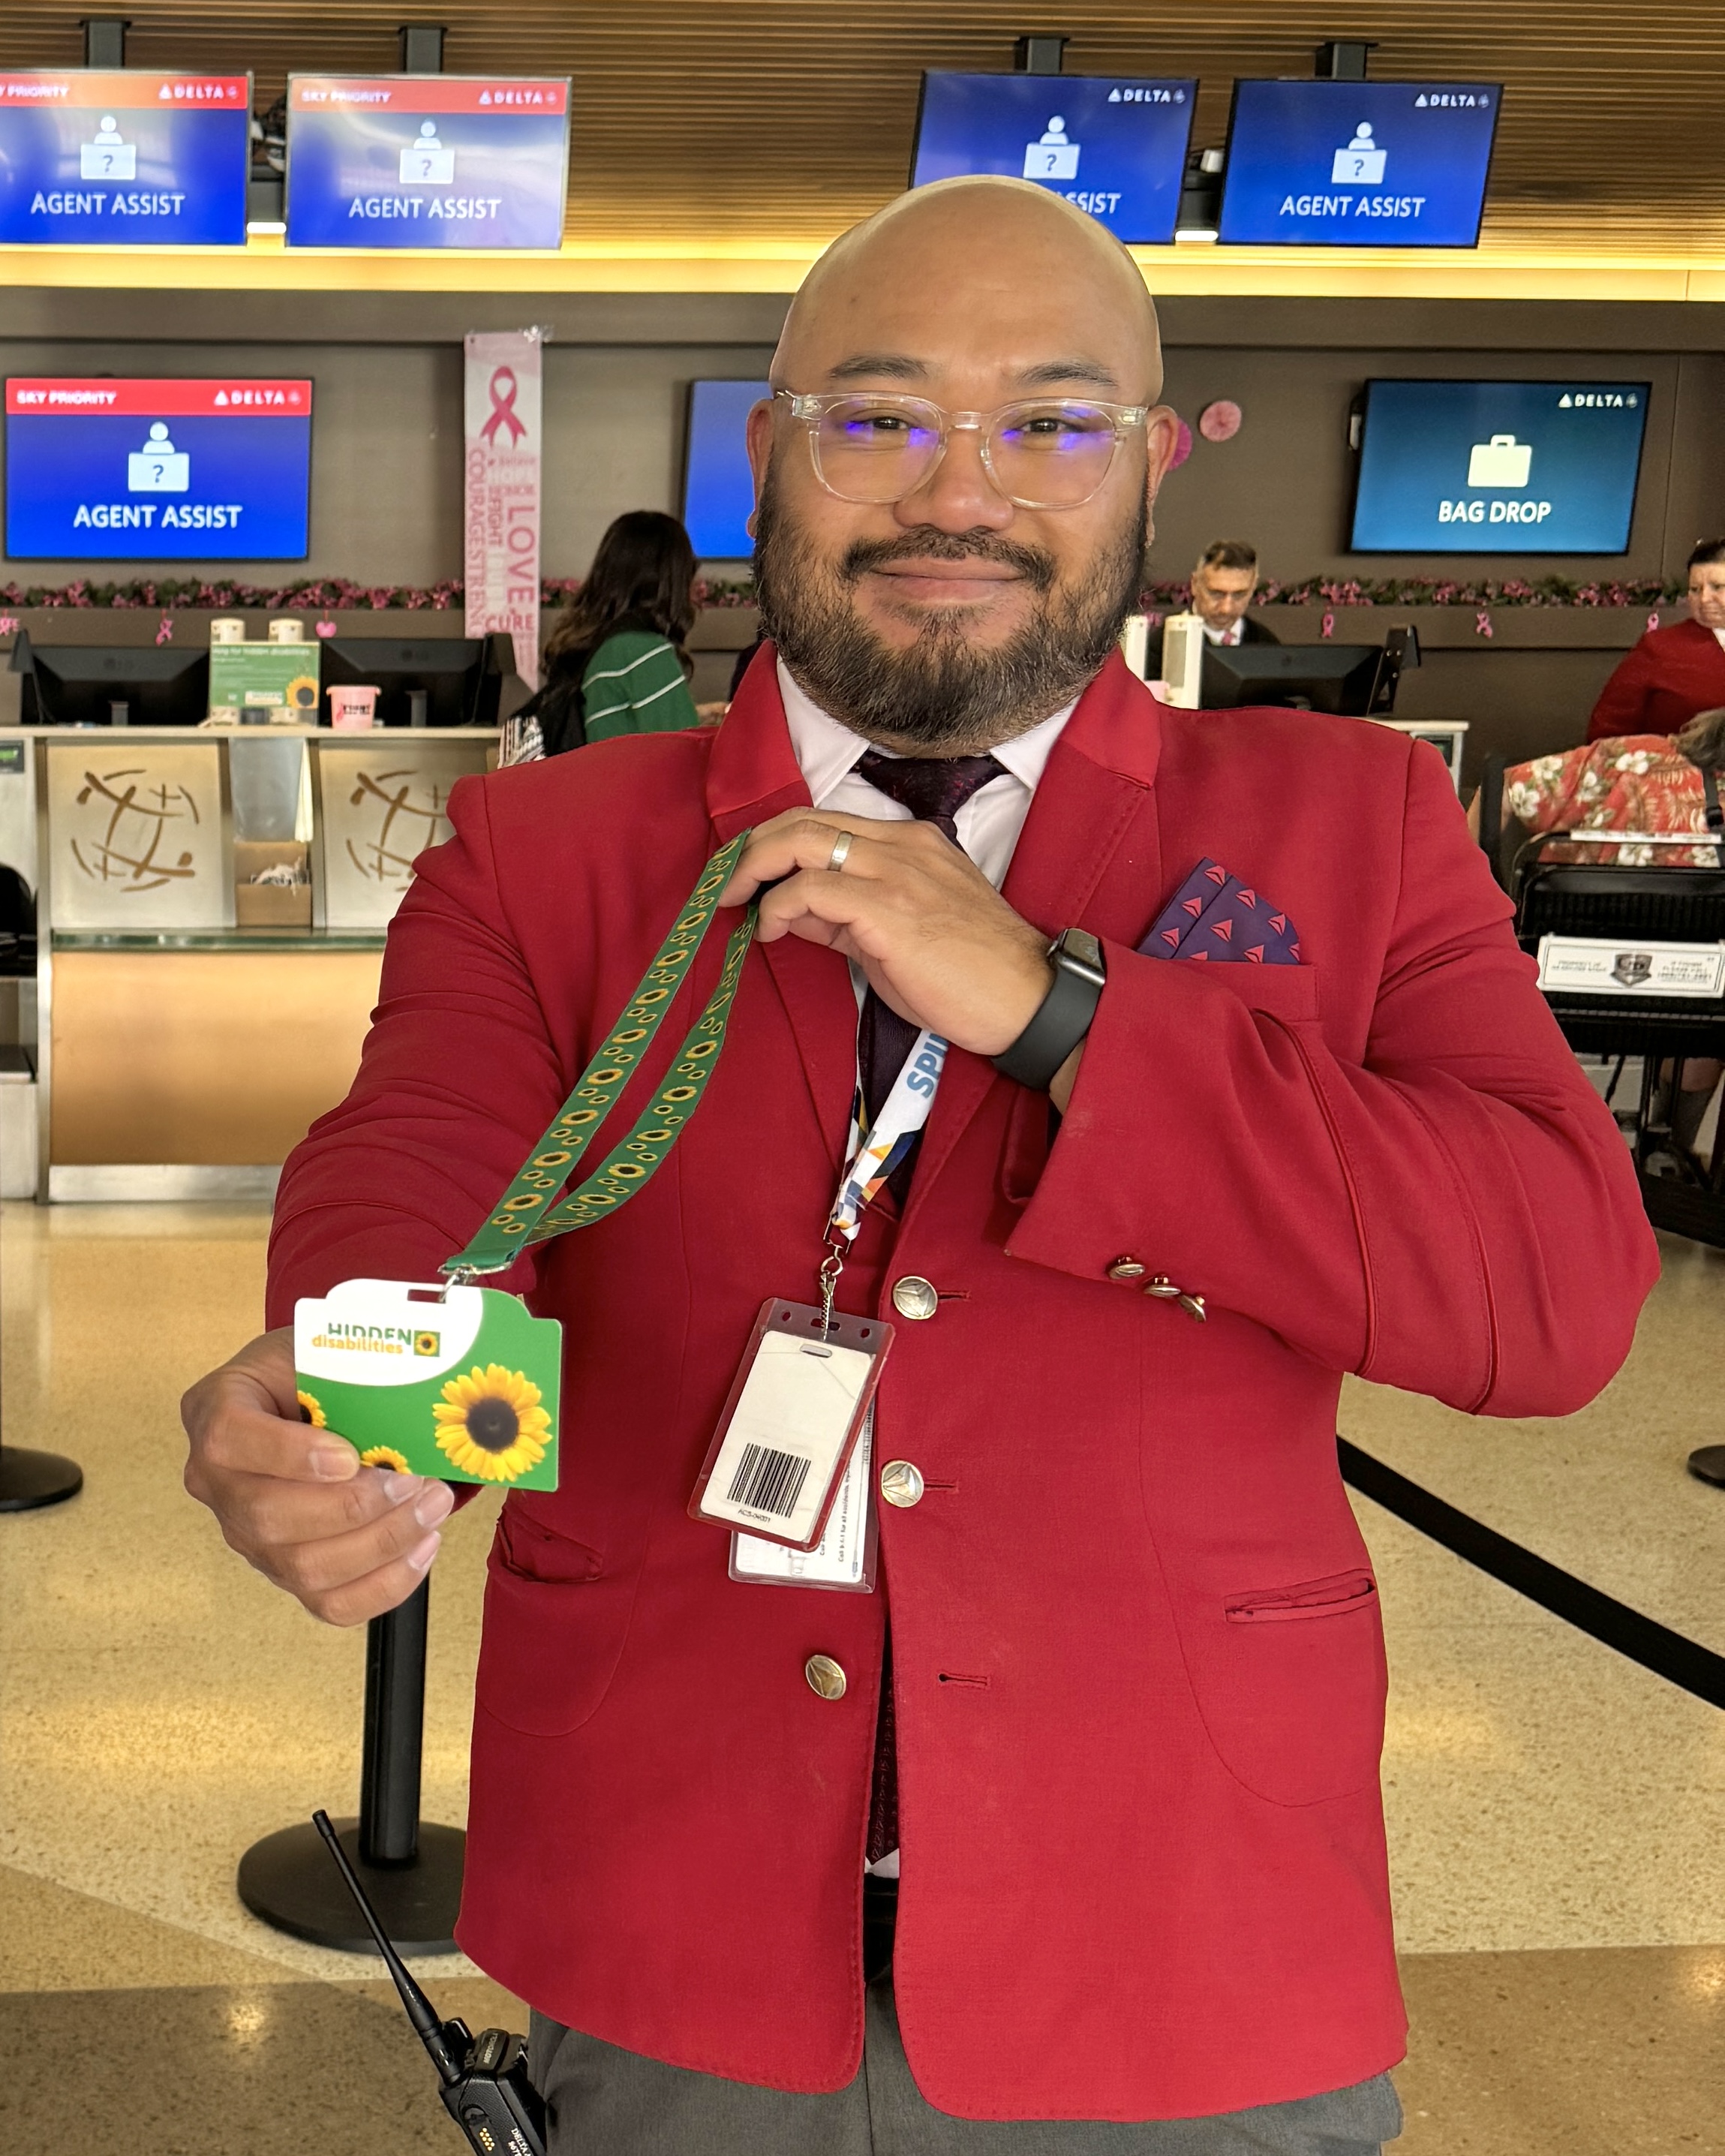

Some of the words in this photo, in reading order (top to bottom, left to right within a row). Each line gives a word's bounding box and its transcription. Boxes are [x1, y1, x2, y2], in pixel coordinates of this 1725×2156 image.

[7, 85, 68, 98] PRIORITY
[174, 86, 224, 100] DELTA
[301, 91, 327, 102] SKY
[330, 91, 391, 103] PRIORITY
[494, 92, 542, 104] DELTA
[1123, 90, 1171, 103] DELTA
[1430, 95, 1475, 107] DELTA
[31, 192, 107, 215] AGENT
[113, 193, 185, 215] ASSIST
[348, 197, 422, 219] AGENT
[428, 198, 502, 219] ASSIST
[1057, 191, 1122, 214] SSIST
[1279, 195, 1350, 217] AGENT
[1354, 197, 1425, 218] ASSIST
[17, 390, 46, 404] SKY
[49, 390, 117, 404] PRIORITY
[231, 391, 285, 405] DELTA
[1574, 394, 1623, 407] DELTA
[468, 447, 485, 546] COURAGE
[74, 504, 158, 528] AGENT
[161, 504, 243, 528] ASSIST
[1438, 501, 1485, 523] BAG
[1489, 501, 1552, 523] DROP
[507, 507, 536, 604] LOVE
[485, 614, 533, 633] CURE
[311, 1334, 404, 1354] disabilities
[328, 1322, 411, 1346] HIDDEN
[511, 2127, 528, 2153] DELTA
